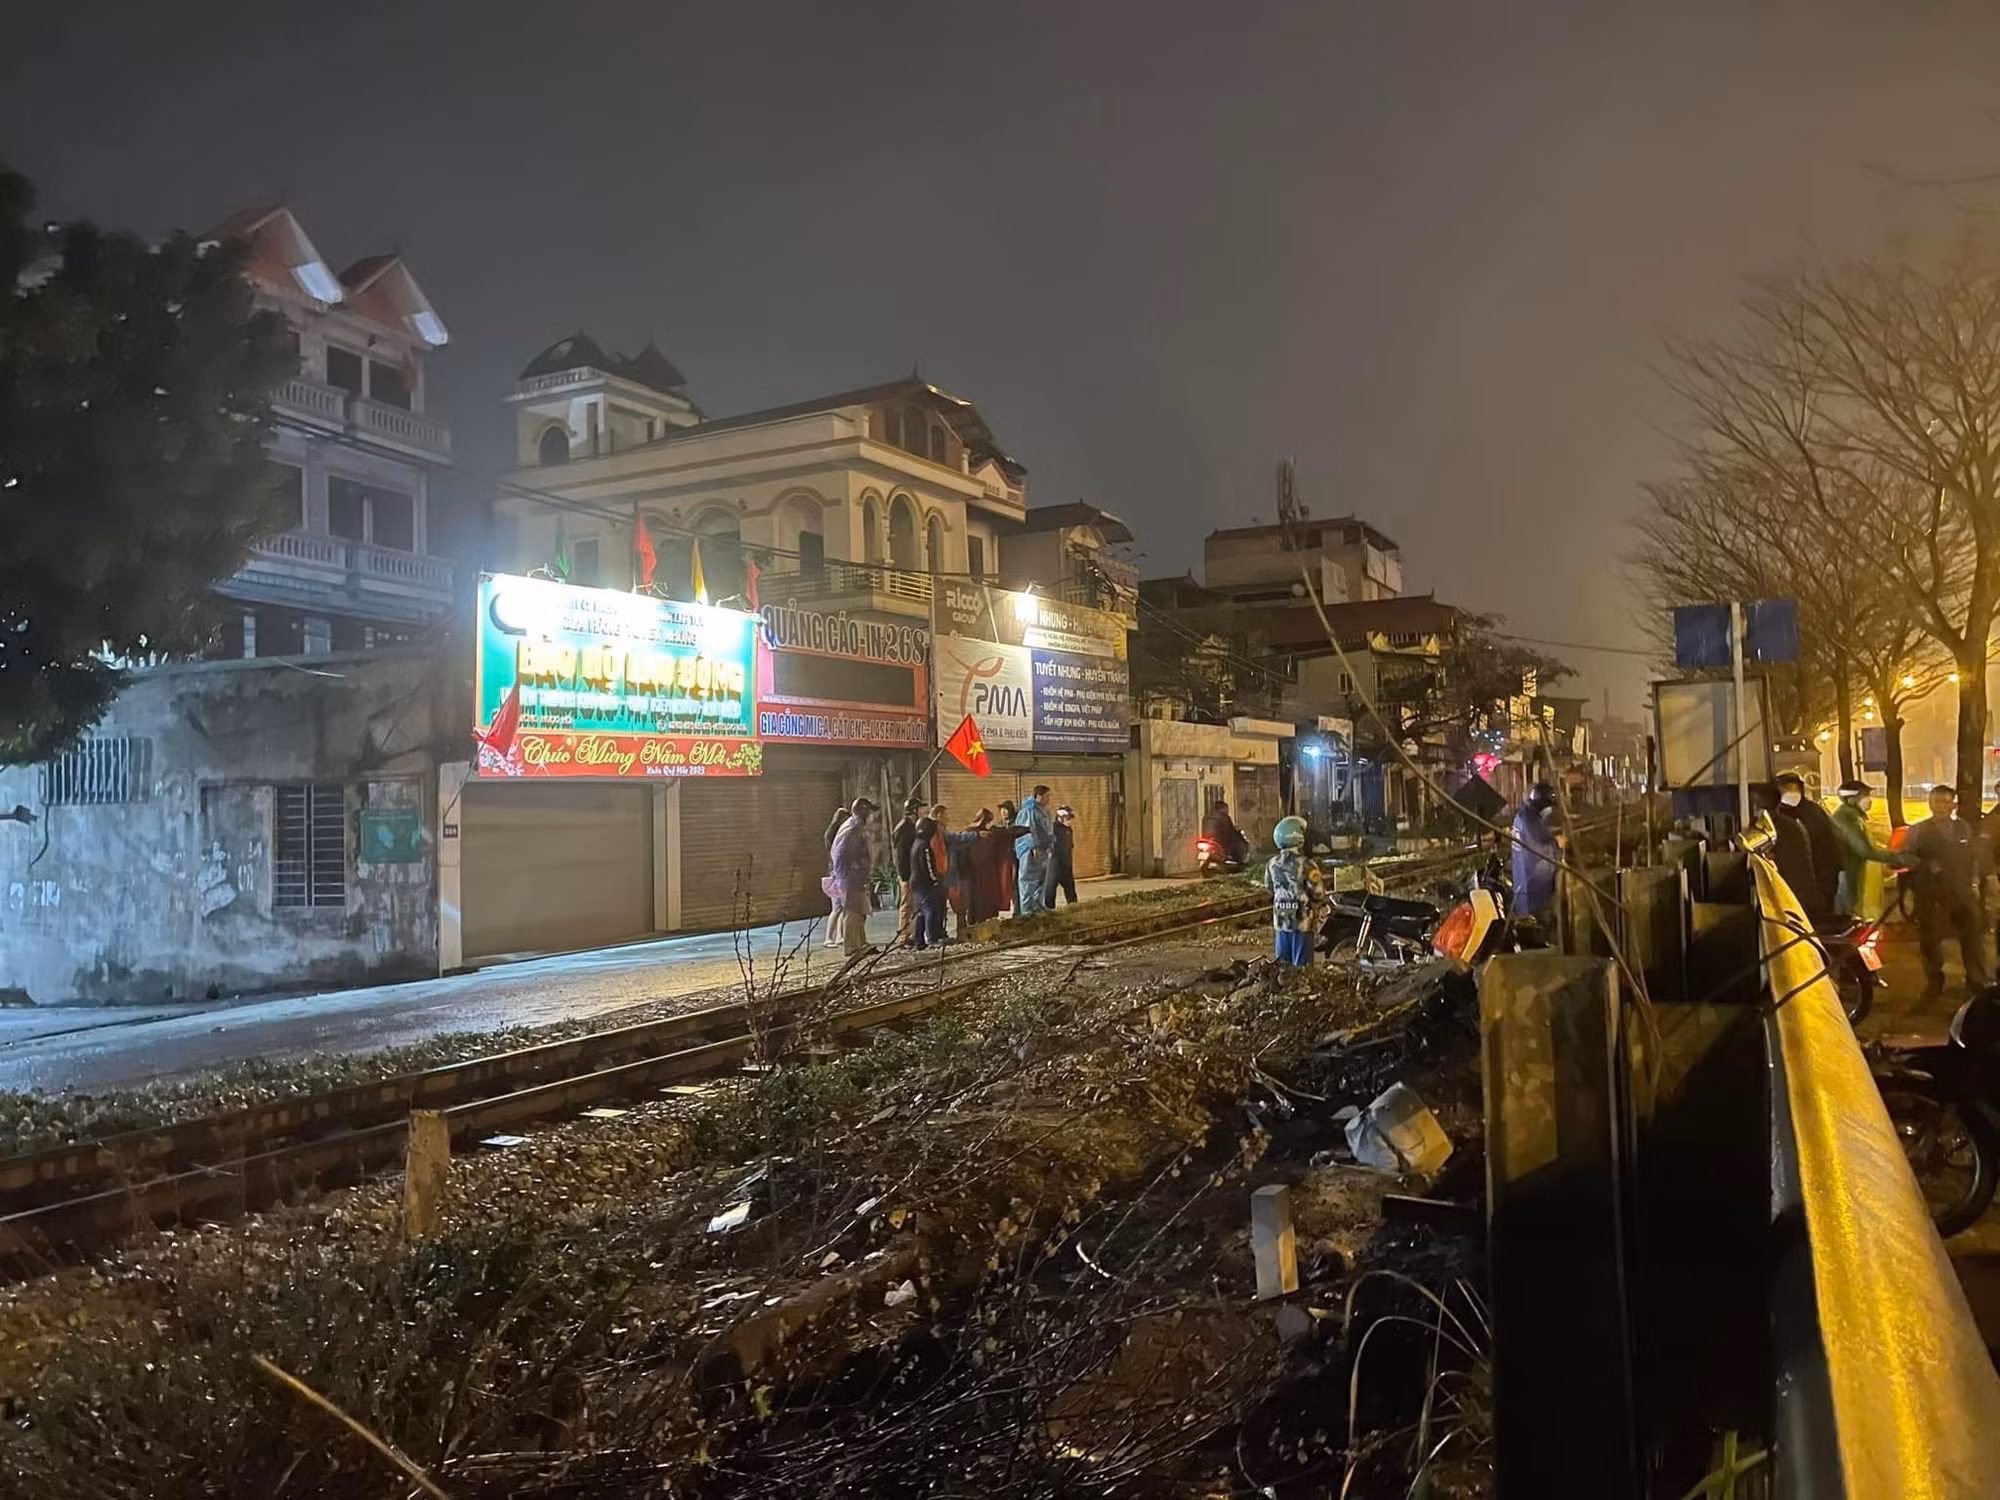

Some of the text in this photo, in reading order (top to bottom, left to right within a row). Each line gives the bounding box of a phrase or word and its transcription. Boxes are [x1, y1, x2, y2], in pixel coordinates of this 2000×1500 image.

[762, 598, 824, 650] QUẢNG
[1039, 608, 1068, 630] NHUNG
[1035, 658, 1056, 677] TUYẾT
[1057, 664, 1081, 680] NHUNG
[974, 683, 1027, 717] PMA
[761, 711, 778, 736] GIA
[778, 708, 804, 737] CÔNG
[520, 735, 727, 775] Chúc Mừng Năm Mới
